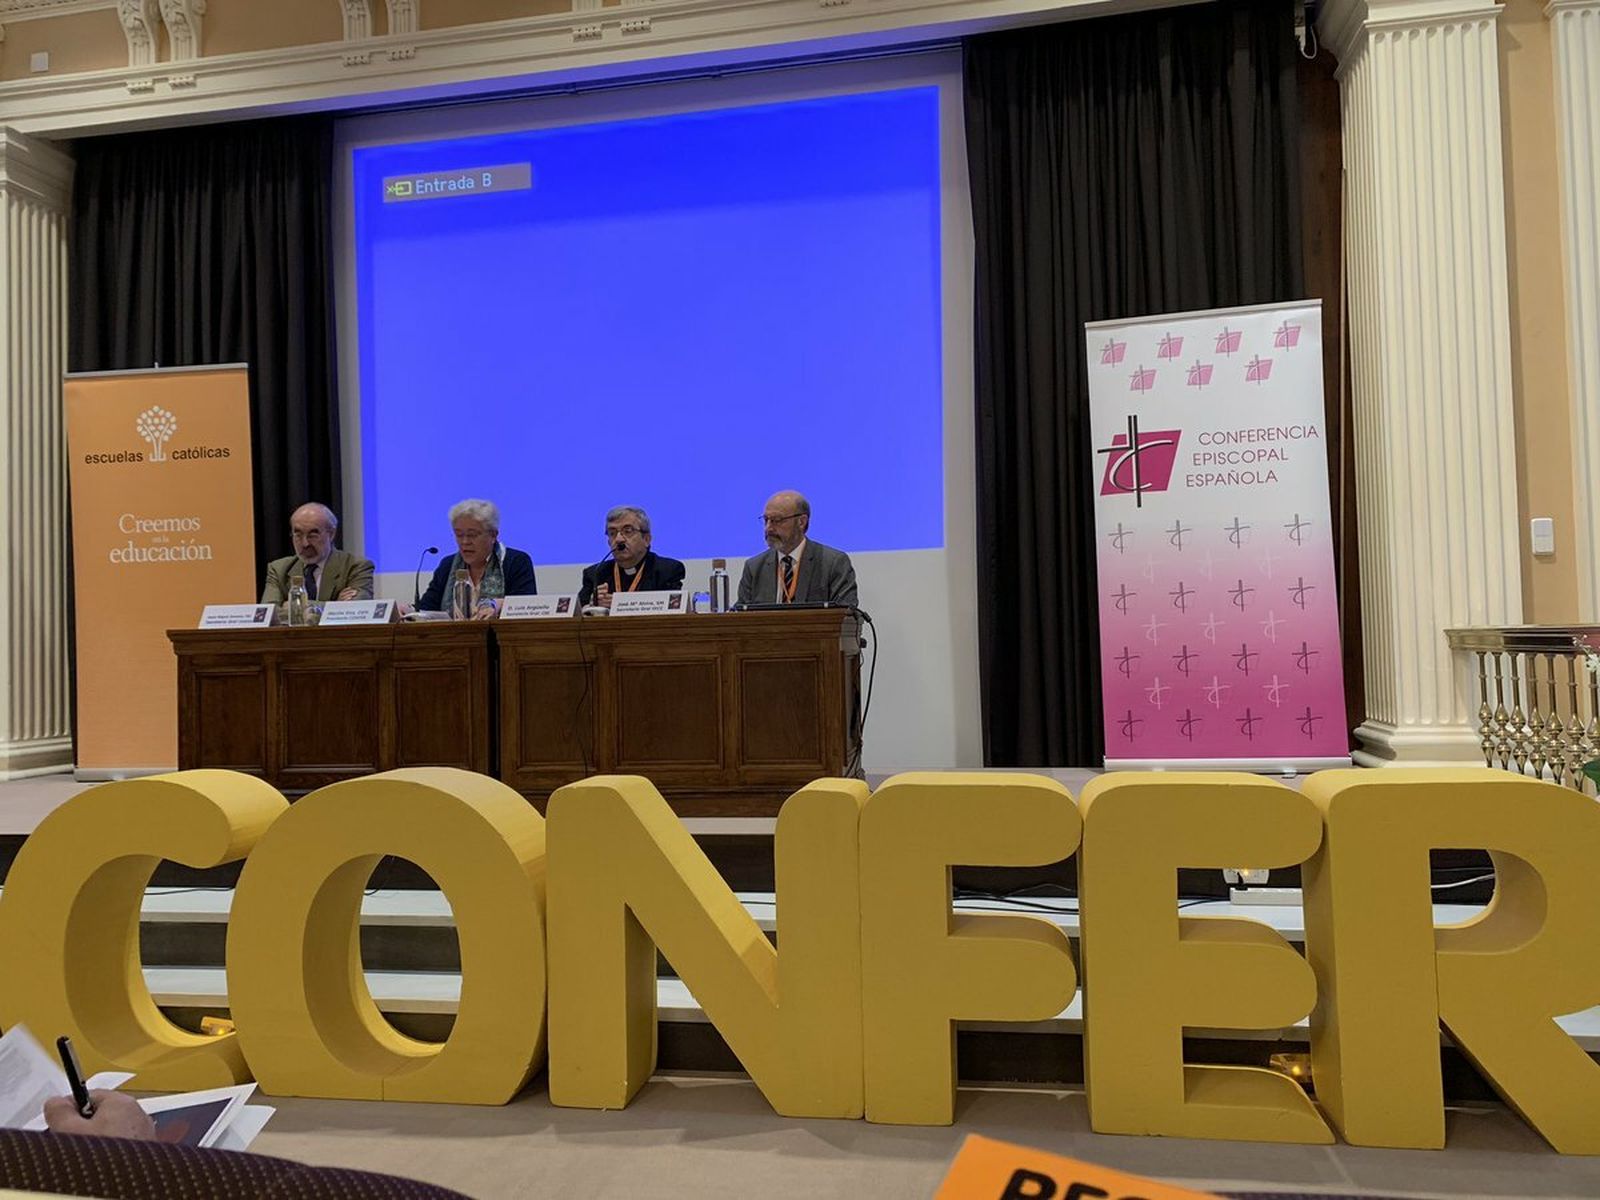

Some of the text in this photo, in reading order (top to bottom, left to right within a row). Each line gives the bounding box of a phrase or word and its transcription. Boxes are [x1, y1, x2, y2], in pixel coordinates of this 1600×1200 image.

[416, 172, 492, 194] Entrada B
[1198, 425, 1319, 446] CONFERENCIA
[84, 446, 231, 464] escuelas católicas
[1192, 448, 1289, 466] EPISCOPAL
[1186, 469, 1278, 487] ESPAÑOLA
[118, 513, 201, 534] Creemos
[109, 539, 213, 563] educación
[0, 767, 1600, 1155] CONFER
